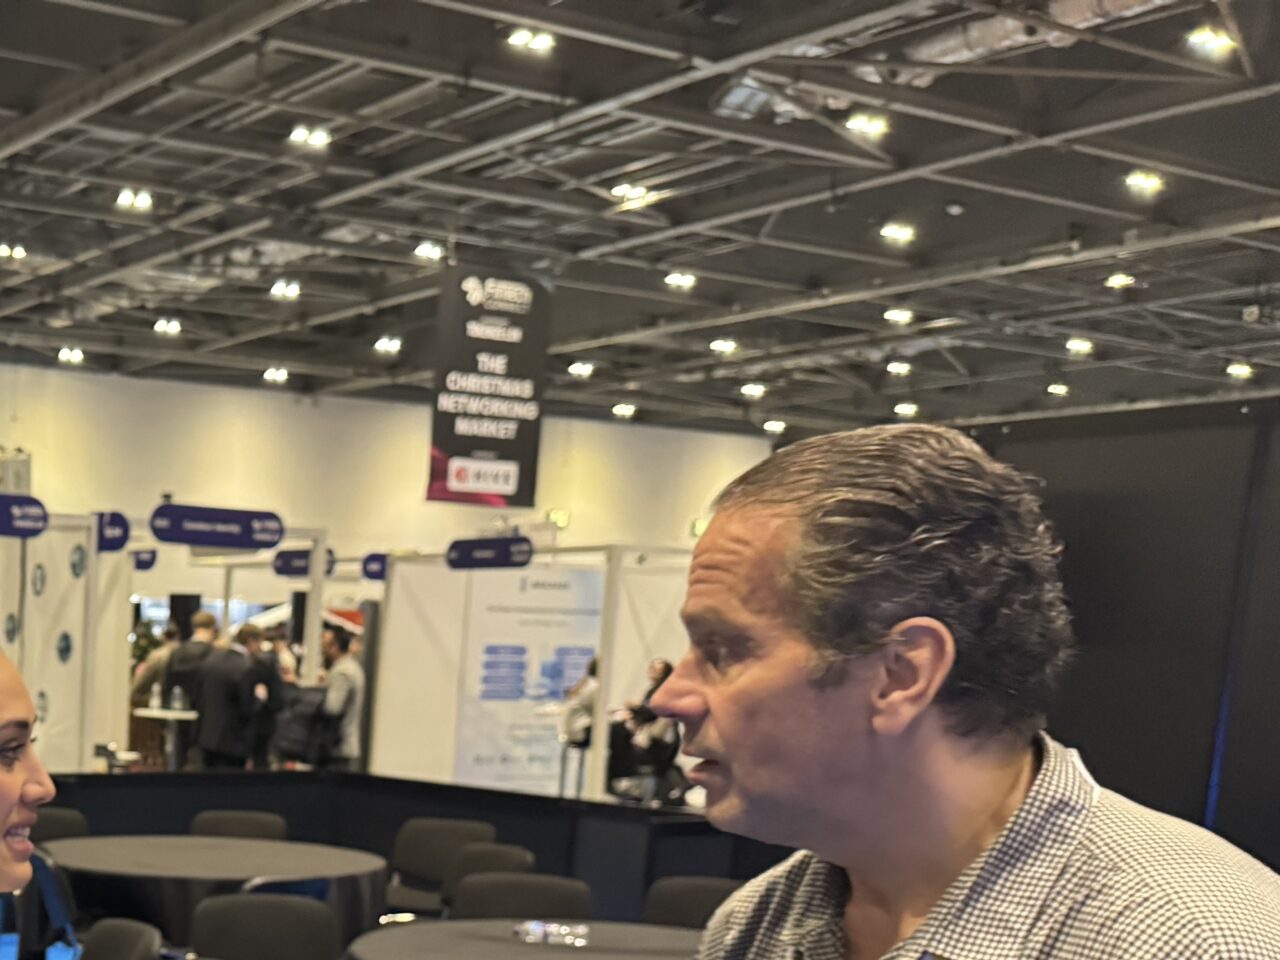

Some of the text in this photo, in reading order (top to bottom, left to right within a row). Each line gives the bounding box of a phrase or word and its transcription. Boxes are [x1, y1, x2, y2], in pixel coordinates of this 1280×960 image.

[476, 352, 508, 374] THE
[446, 370, 534, 399] CHRISTMAS
[437, 391, 539, 420] NETWORKING
[454, 415, 519, 439] MARKET
